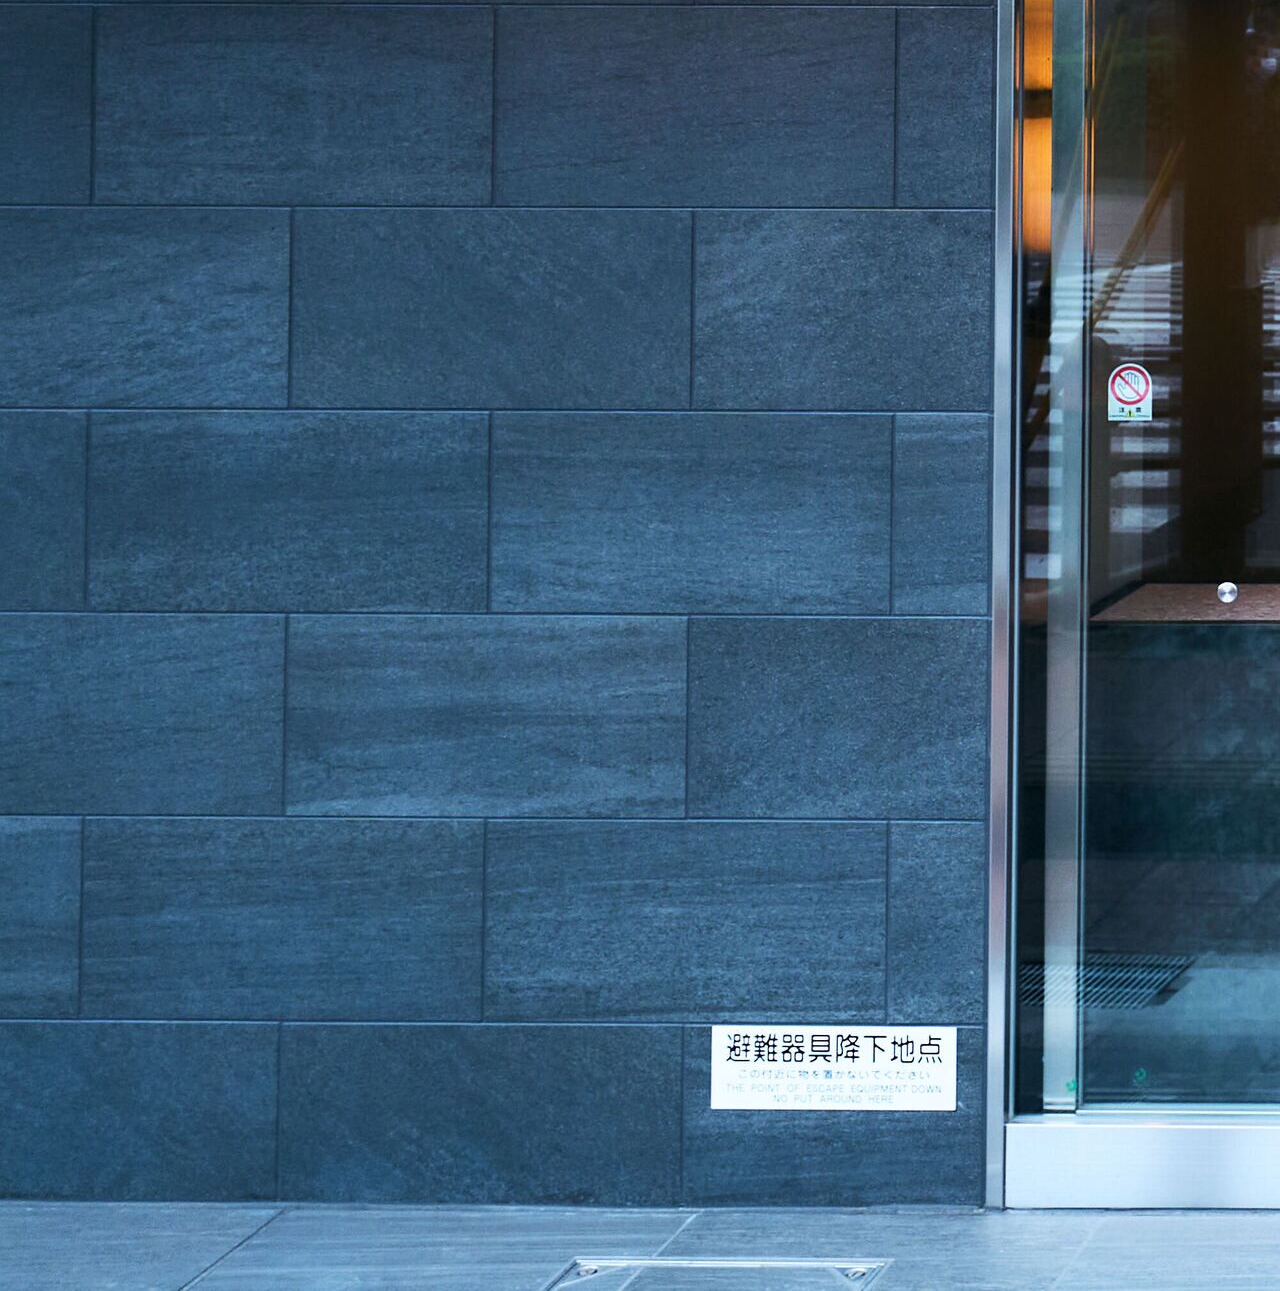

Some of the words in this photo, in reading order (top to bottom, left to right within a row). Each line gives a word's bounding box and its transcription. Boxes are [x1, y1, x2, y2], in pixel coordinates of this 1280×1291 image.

[725, 1033, 943, 1064] 避難器具降下地点
[752, 1083, 780, 1093] POINT
[806, 1083, 845, 1093] ESCAPE
[850, 1083, 907, 1094] EQUIPMENT
[911, 1084, 942, 1094] DOWN
